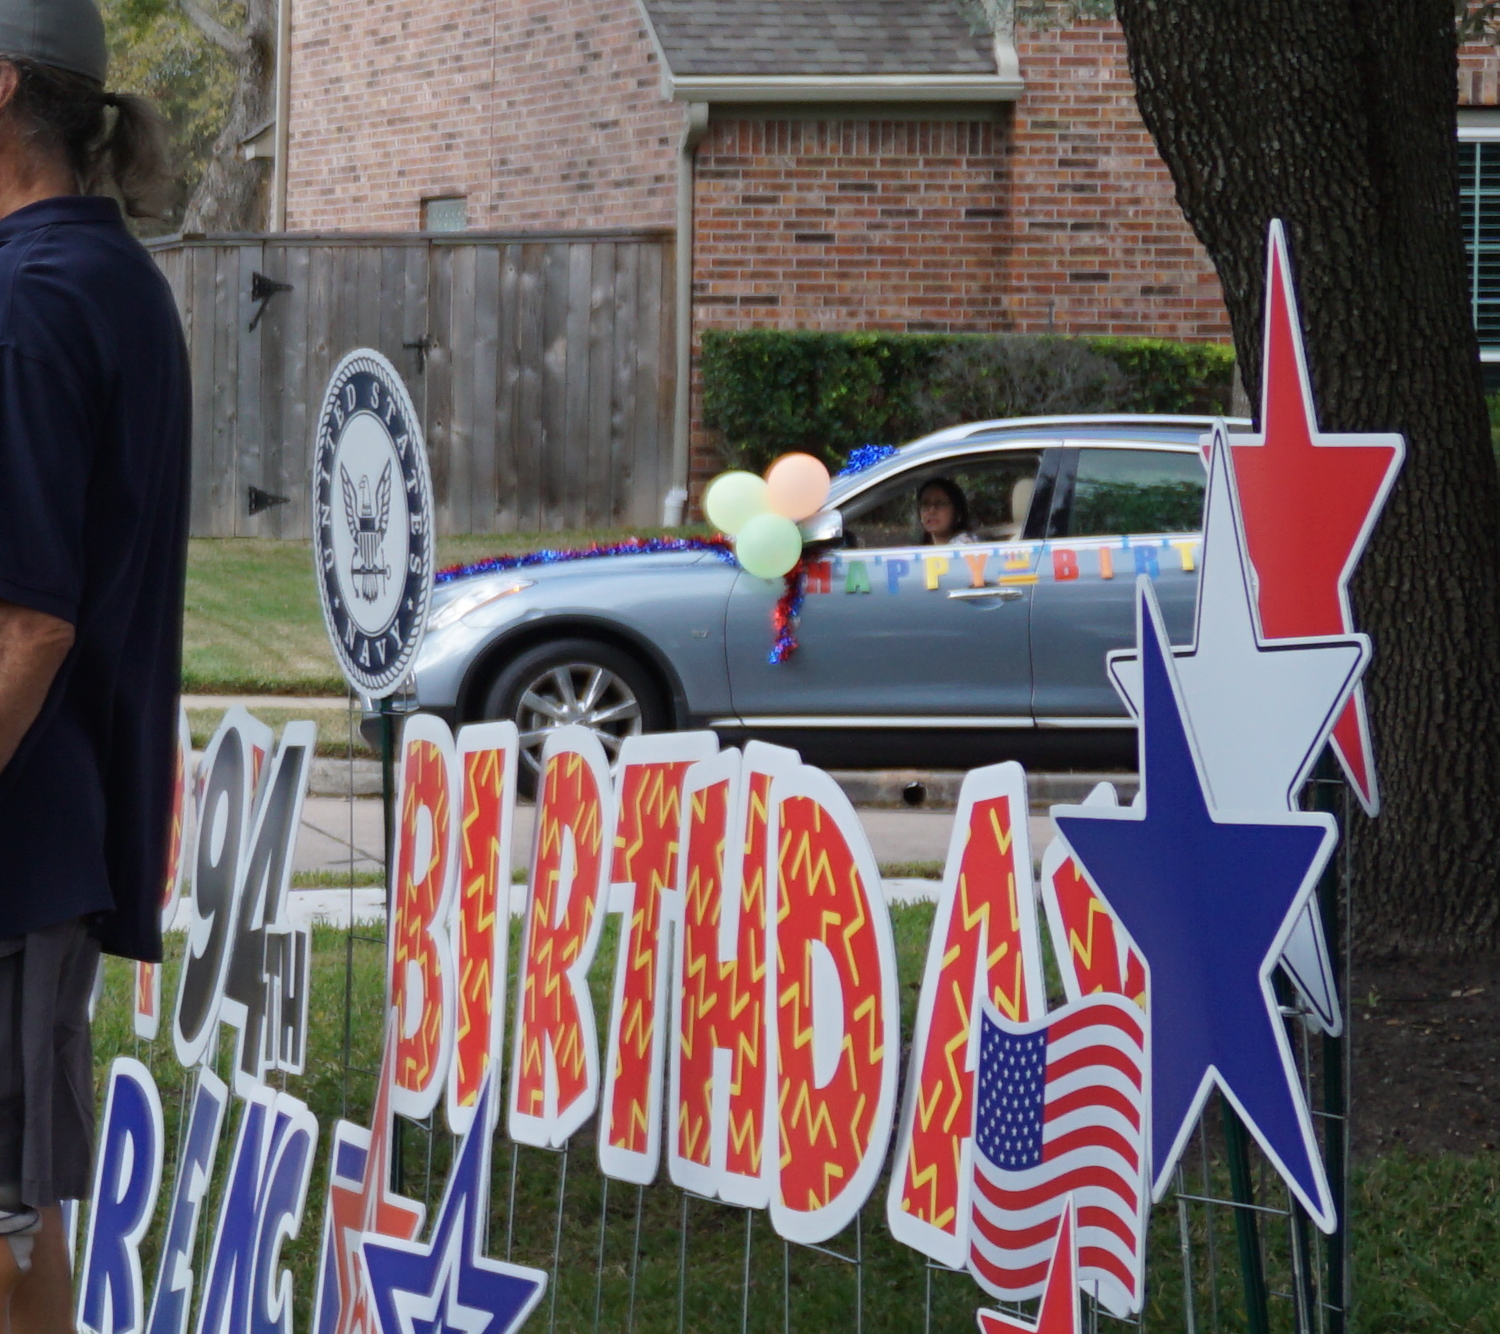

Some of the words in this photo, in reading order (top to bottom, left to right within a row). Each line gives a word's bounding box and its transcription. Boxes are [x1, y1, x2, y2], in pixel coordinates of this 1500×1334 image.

[320, 383, 358, 572] UNITED
[370, 381, 424, 576] STATES
[804, 553, 990, 594] HAPPY
[1052, 542, 1197, 582] BIRT
[343, 617, 405, 667] NAVY
